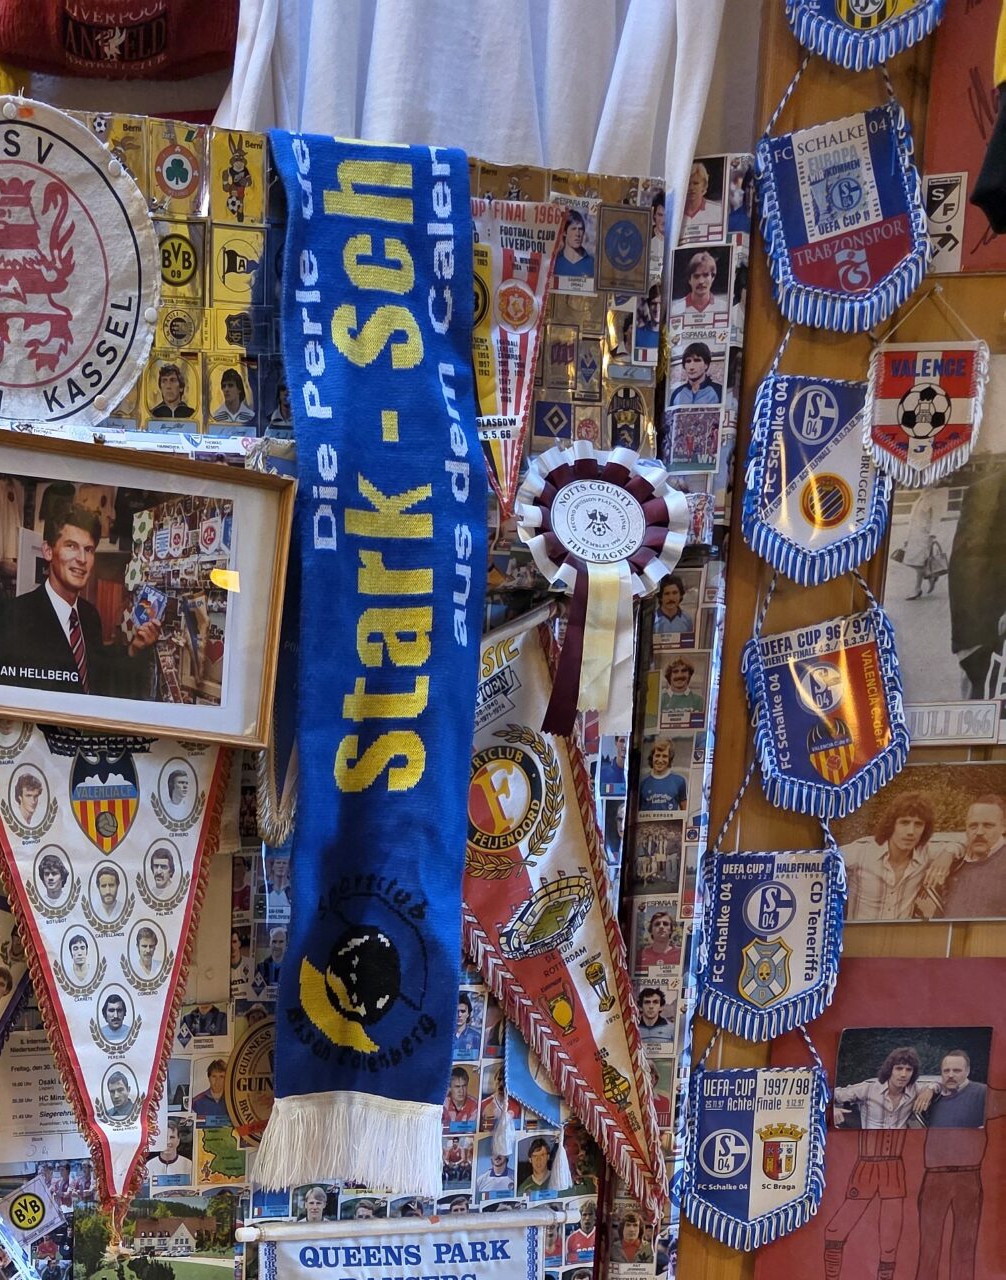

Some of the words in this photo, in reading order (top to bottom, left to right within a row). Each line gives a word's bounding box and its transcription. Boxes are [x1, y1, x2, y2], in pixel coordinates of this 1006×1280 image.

[774, 147, 793, 163] FC
[797, 124, 865, 156] SCHALKE
[869, 120, 888, 134] 04
[499, 226, 535, 241] FOOTBALL
[536, 230, 556, 242] CLUB
[818, 222, 840, 236] UEFA
[843, 215, 862, 228] CUP
[500, 235, 546, 254] LIVERPOOL
[794, 220, 905, 267] TRABZONSPOR
[161, 243, 192, 269] BVB
[171, 270, 182, 279] 09
[295, 250, 332, 419] Perle
[42, 296, 132, 412] KASSEL
[891, 358, 967, 378] VALENCE
[482, 429, 511, 439] 5.5.66
[313, 443, 338, 551] Die
[559, 483, 587, 507] NOTTS
[589, 483, 634, 508] COUNTY
[567, 537, 588, 557] THE
[591, 538, 637, 561] MAGPIES
[761, 637, 793, 657] UEFA
[797, 630, 822, 648] CUP
[826, 618, 870, 642] 96/97
[19, 666, 80, 684] HELLBERG
[769, 673, 780, 691] 04
[772, 695, 789, 748] Schalke
[780, 751, 792, 770] FC
[473, 799, 540, 848] FEIJENOORD
[722, 863, 745, 874] UEFA
[746, 863, 764, 874] CUP
[776, 863, 826, 874] HALBFINALE
[720, 882, 733, 900] 04
[810, 881, 823, 903] CD
[715, 905, 731, 961] Schalke
[804, 909, 822, 982] Teneriffa
[712, 966, 725, 983] FC
[238, 1030, 273, 1076] GUINNESS
[703, 1079, 756, 1097] UEFA-CUP
[763, 1078, 810, 1096] 1997/98
[727, 1097, 782, 1112] Achtelfinale
[708, 1183, 737, 1191] Schalke
[773, 1183, 796, 1191] Braga
[14, 1200, 42, 1225] BVB
[299, 1245, 422, 1268] QUEENS
[433, 1239, 510, 1264] PARK
